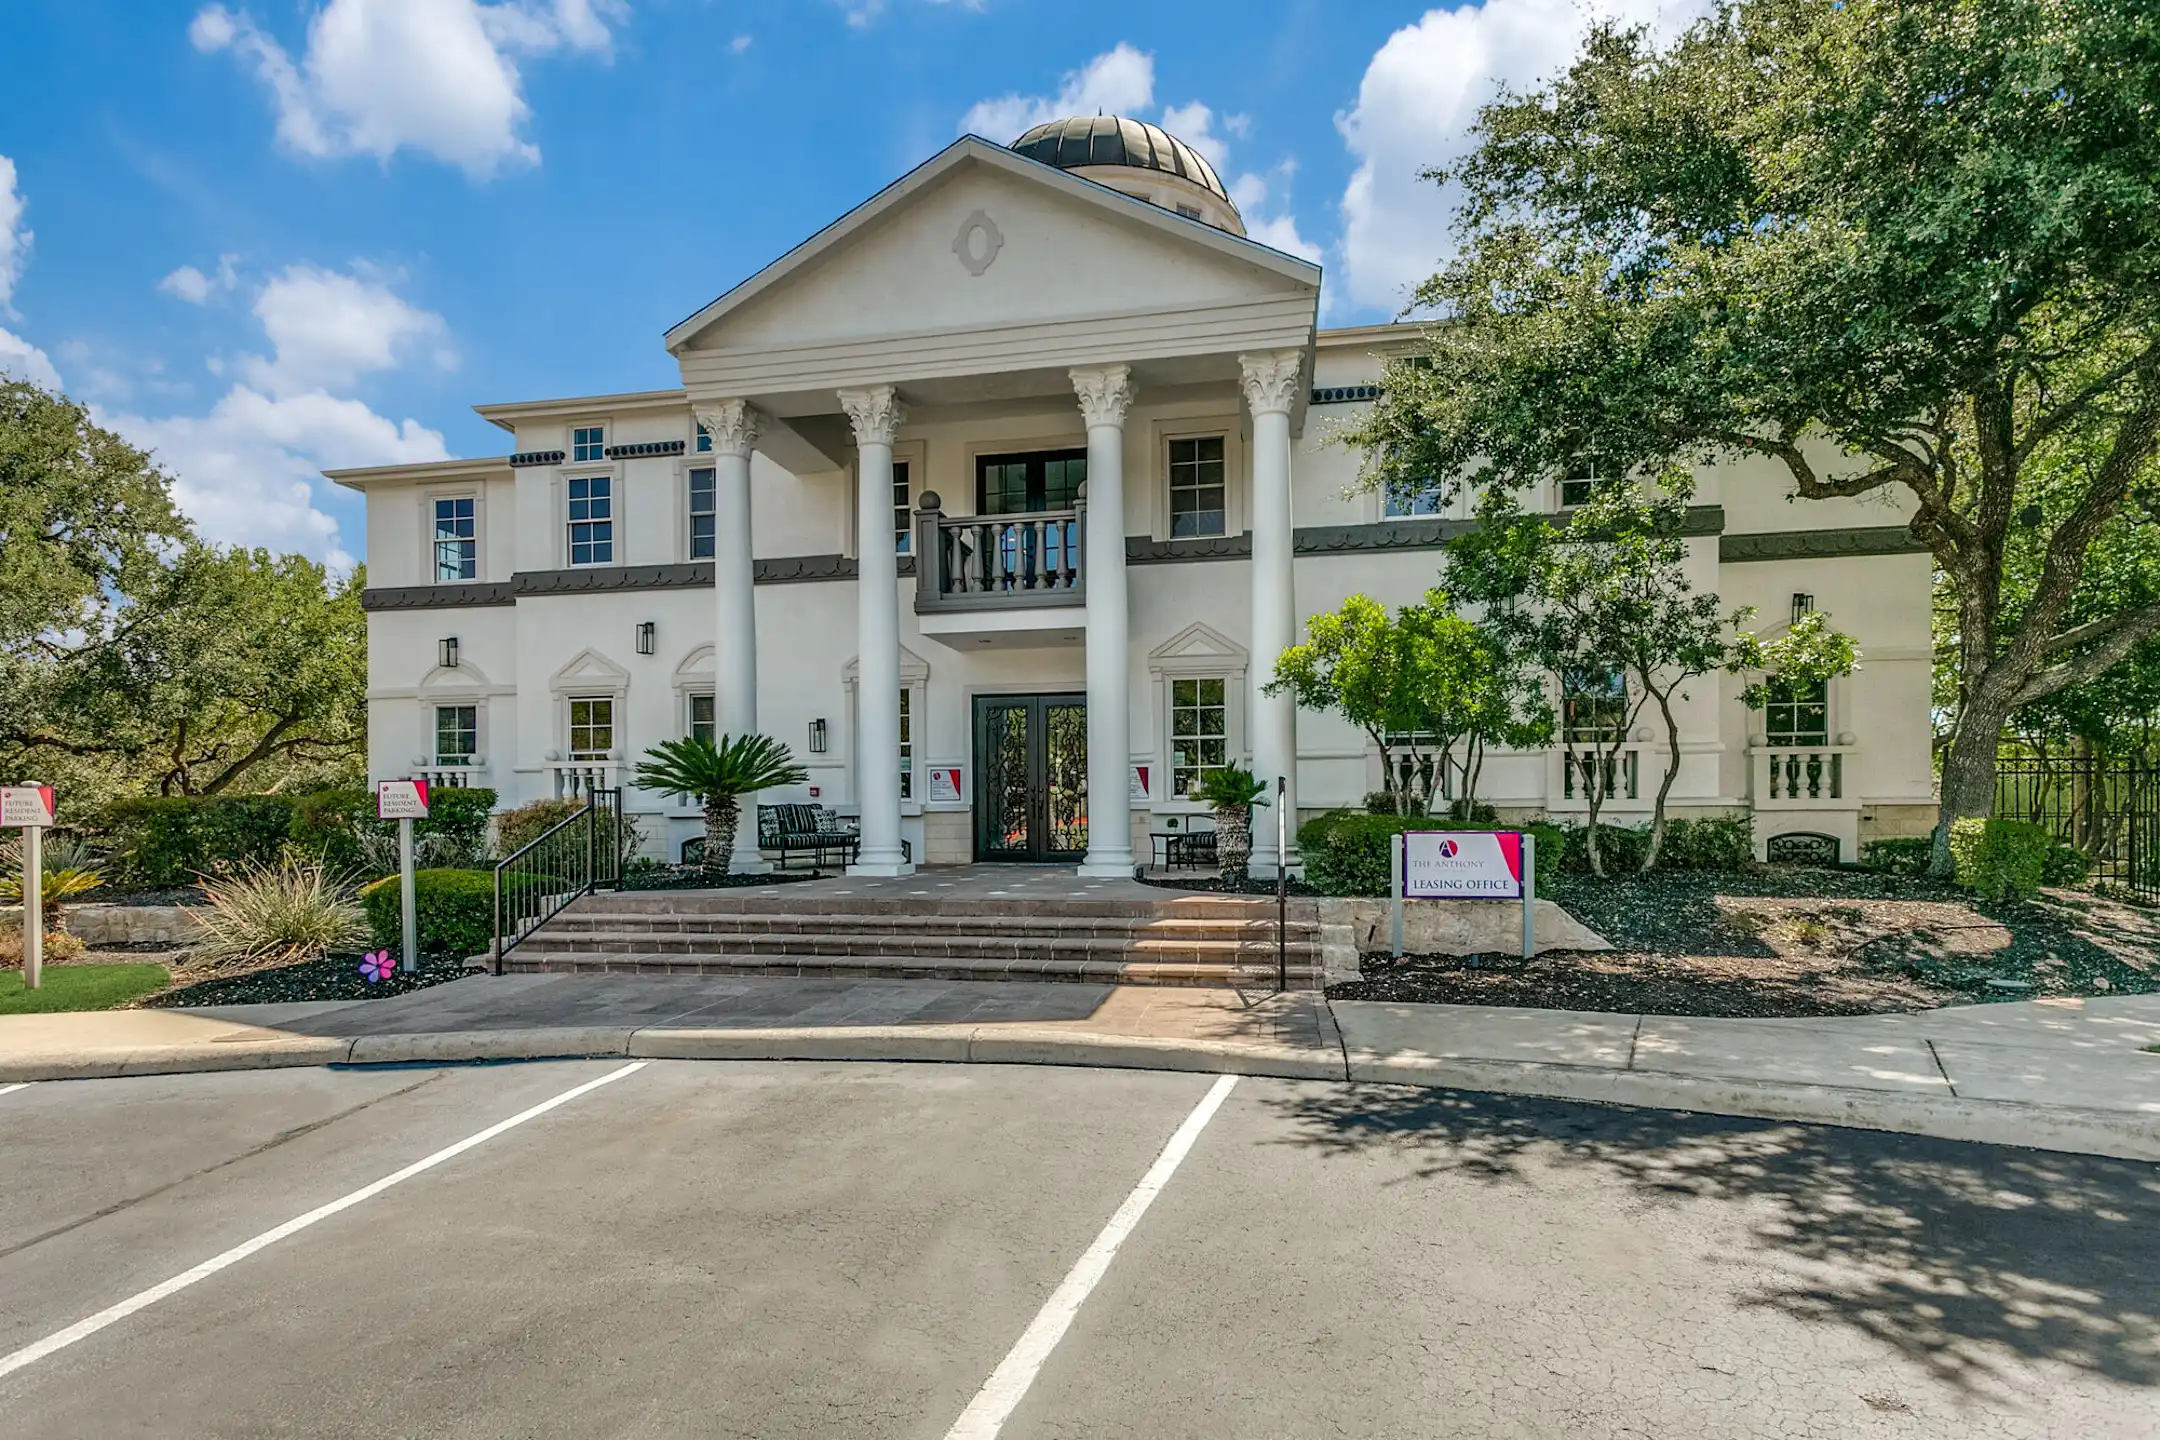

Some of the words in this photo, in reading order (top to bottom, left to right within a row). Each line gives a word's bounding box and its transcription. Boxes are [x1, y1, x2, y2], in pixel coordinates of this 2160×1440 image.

[1412, 860, 1431, 868] THE
[1434, 860, 1485, 868] ANTHONY
[1413, 880, 1462, 889] LEASING
[1466, 880, 1508, 889] OFFICE
